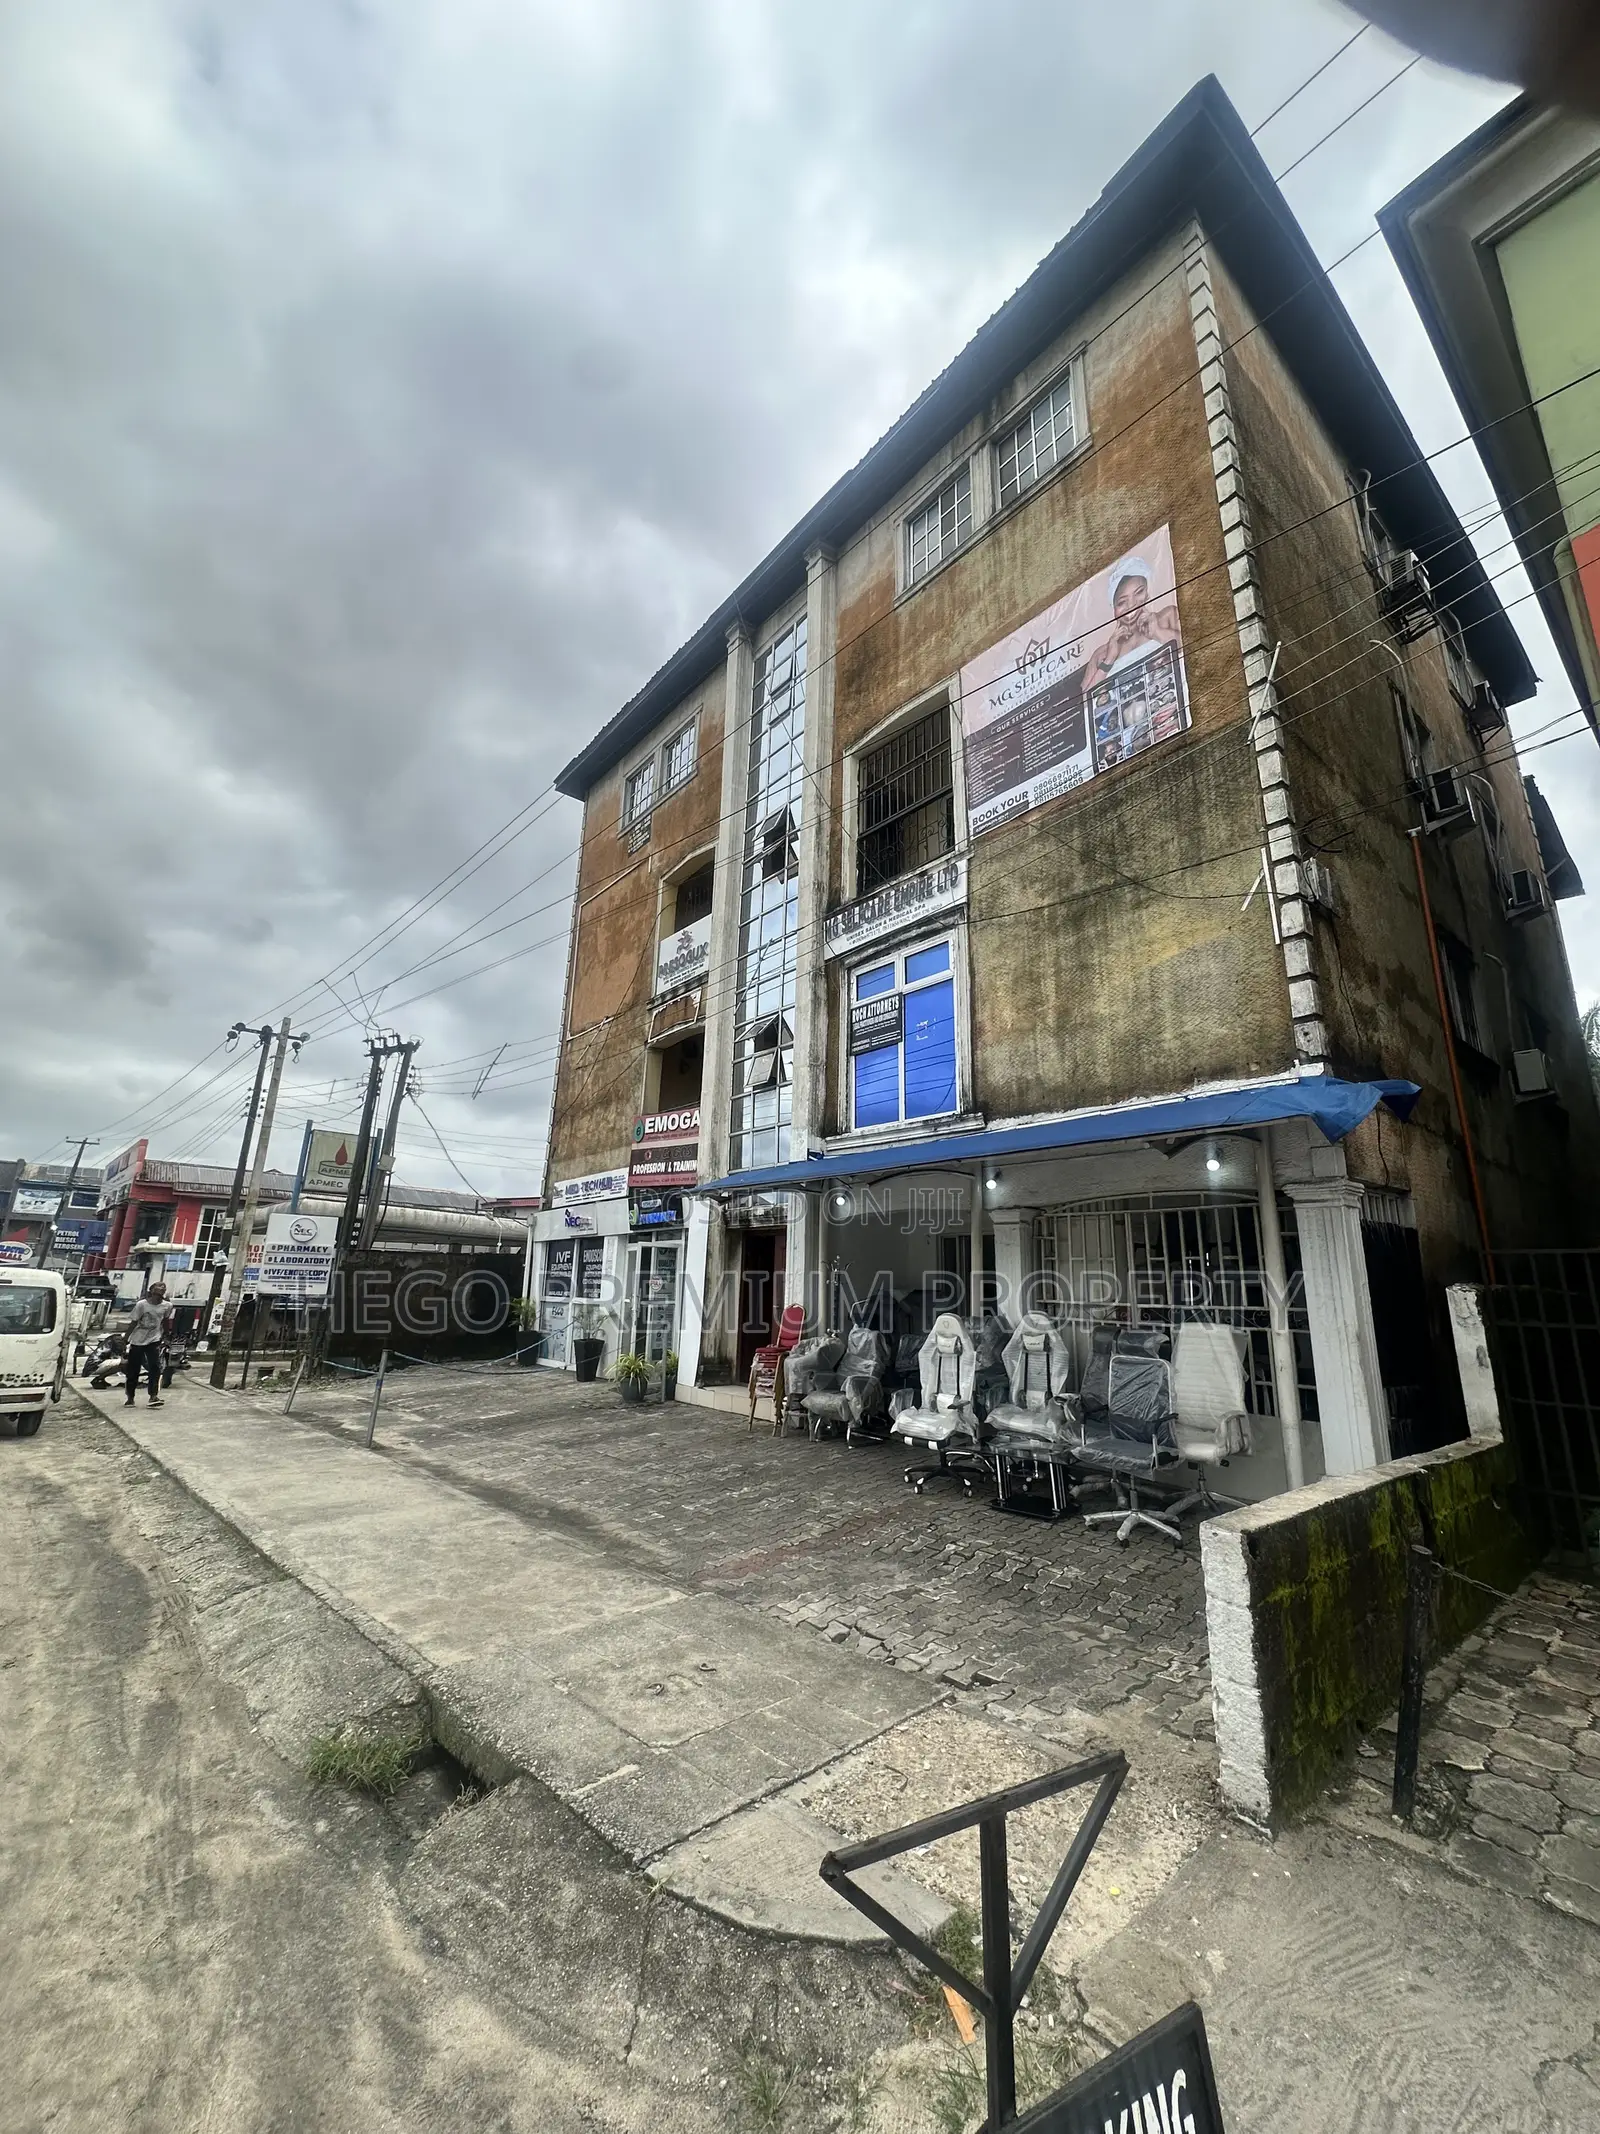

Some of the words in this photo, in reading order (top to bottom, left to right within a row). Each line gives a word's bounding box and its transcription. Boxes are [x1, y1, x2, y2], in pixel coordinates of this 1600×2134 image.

[989, 689, 1014, 710] MG
[1015, 640, 1085, 694] SELFCARE
[996, 719, 1011, 733] OUR
[1012, 701, 1045, 724] SERVICES
[972, 804, 999, 827] BOOK
[1000, 790, 1029, 811] YOUR
[936, 863, 959, 894] LTD
[865, 921, 882, 933] SALON
[914, 903, 926, 913] SPA
[867, 995, 900, 1018] ATTORNEYS
[632, 1162, 672, 1175] PROFESSIONL
[308, 1178, 344, 1189] APMEC
[274, 1256, 331, 1265] LABORATORY
[277, 1245, 328, 1253] PHARMACY
[556, 1250, 571, 1263] IVF
[1104, 2068, 1196, 2134] NG
